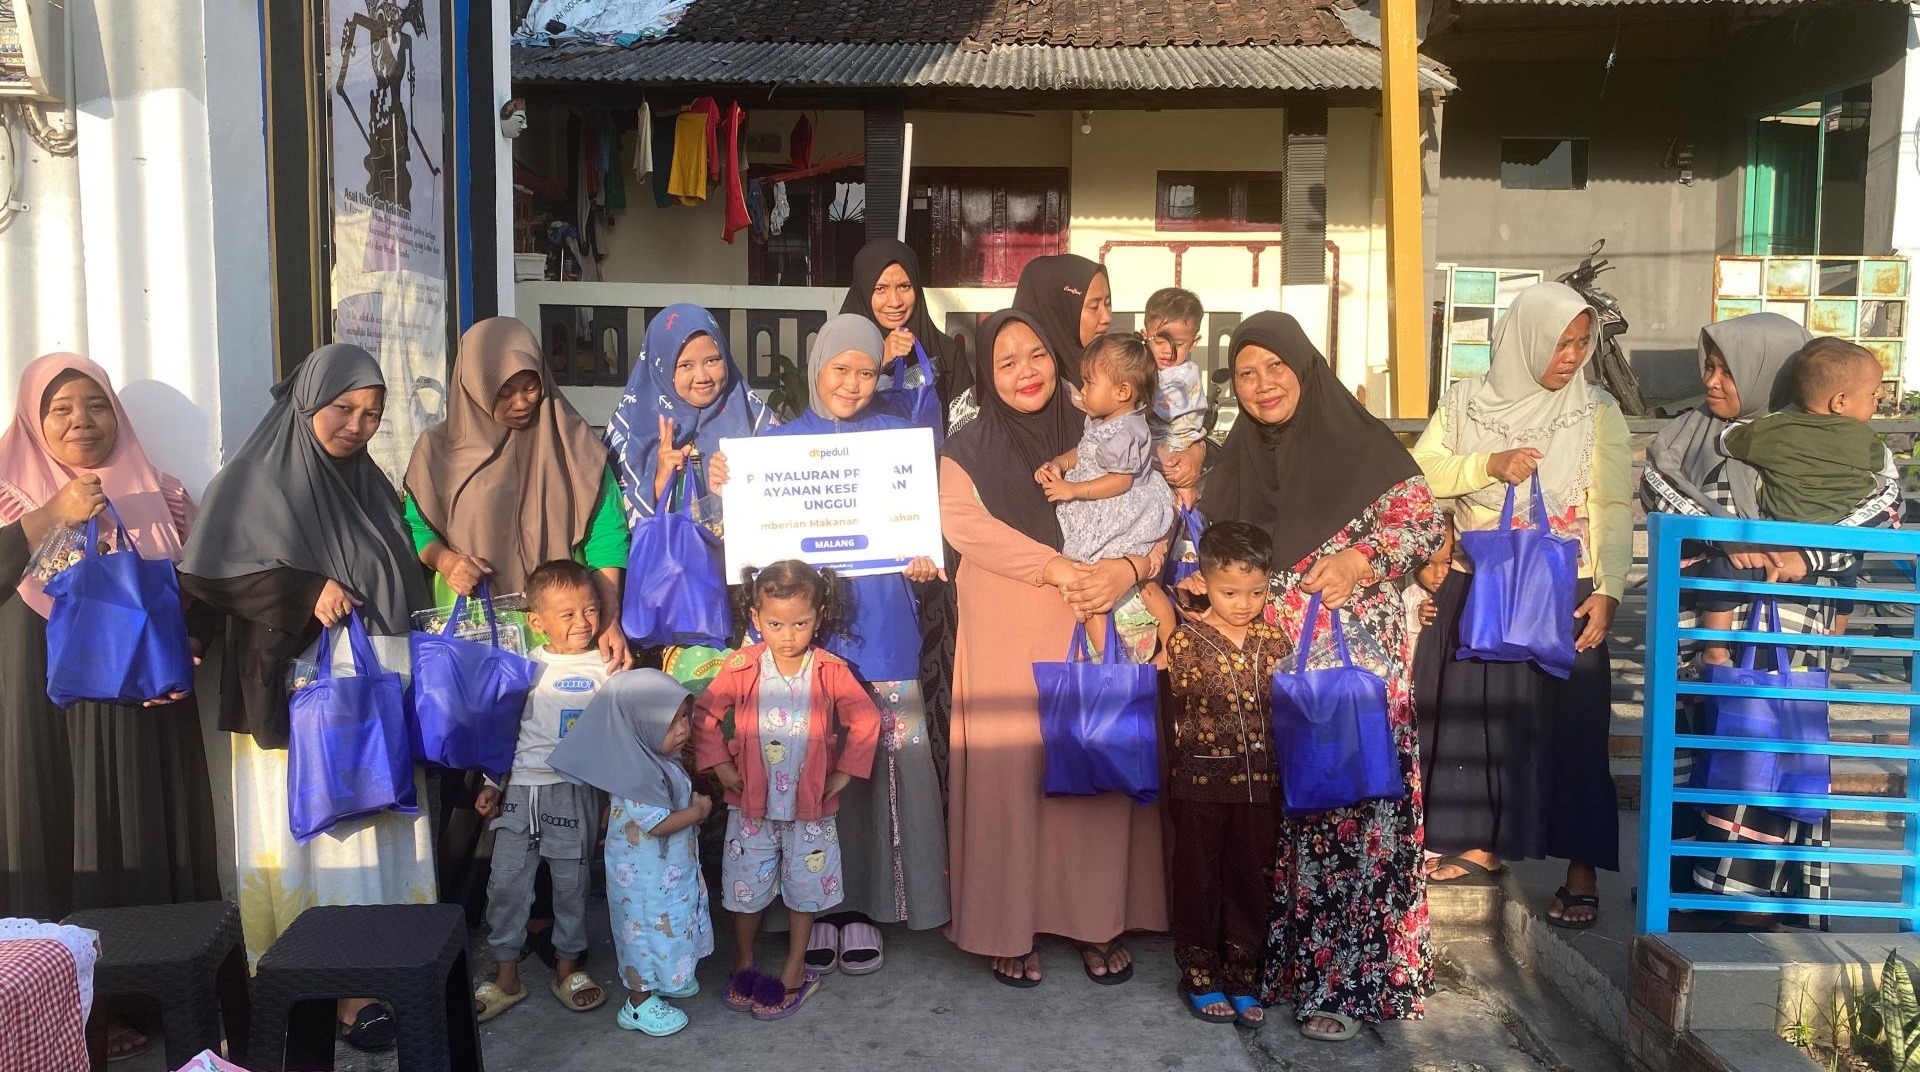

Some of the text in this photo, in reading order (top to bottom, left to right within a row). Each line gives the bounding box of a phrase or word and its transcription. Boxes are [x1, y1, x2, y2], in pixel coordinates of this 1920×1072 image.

[344, 187, 358, 203] Asal
[360, 192, 373, 208] Usul
[747, 469, 840, 483] PNYALURAN
[763, 484, 821, 497] AYANAN
[1663, 488, 1687, 509] LOVE
[761, 518, 807, 530] mberian
[809, 516, 859, 528] Makanan
[815, 538, 855, 549] MALANG
[541, 813, 580, 829] GOODBOY
